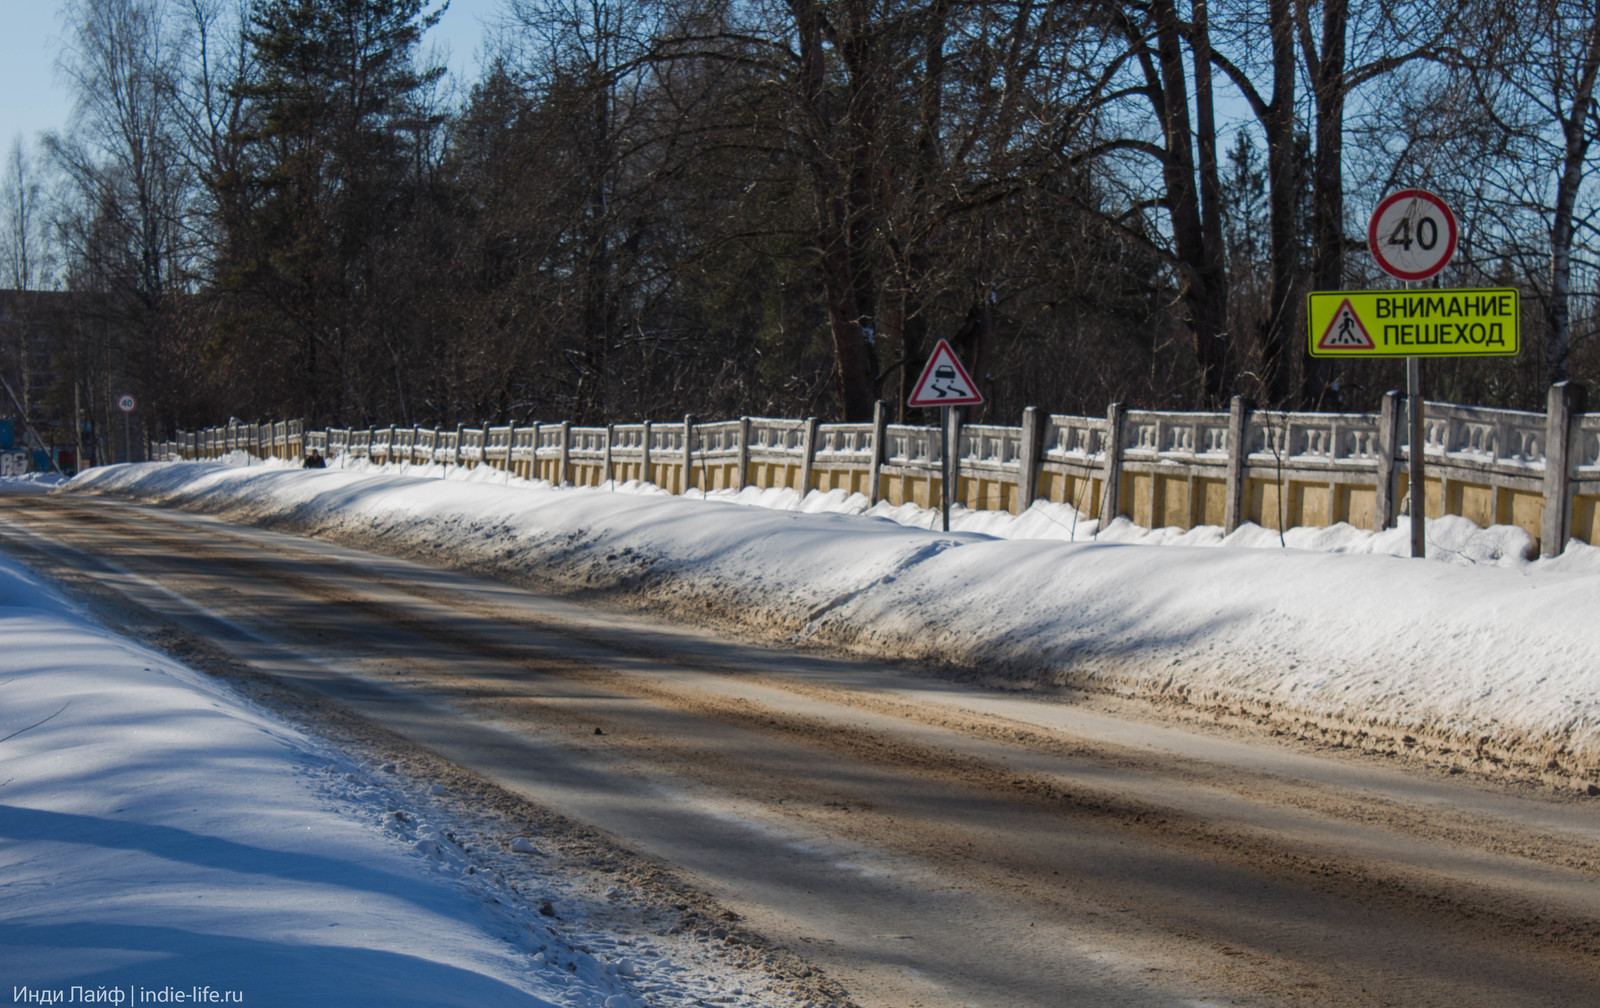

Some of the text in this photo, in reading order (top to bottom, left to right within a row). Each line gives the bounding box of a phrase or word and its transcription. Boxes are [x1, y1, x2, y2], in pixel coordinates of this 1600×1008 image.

[1388, 216, 1438, 251] 40
[1376, 296, 1512, 318] ВНИМАНИЕ
[1384, 323, 1505, 346] ПЕШЕХОД
[121, 399, 133, 408] 40
